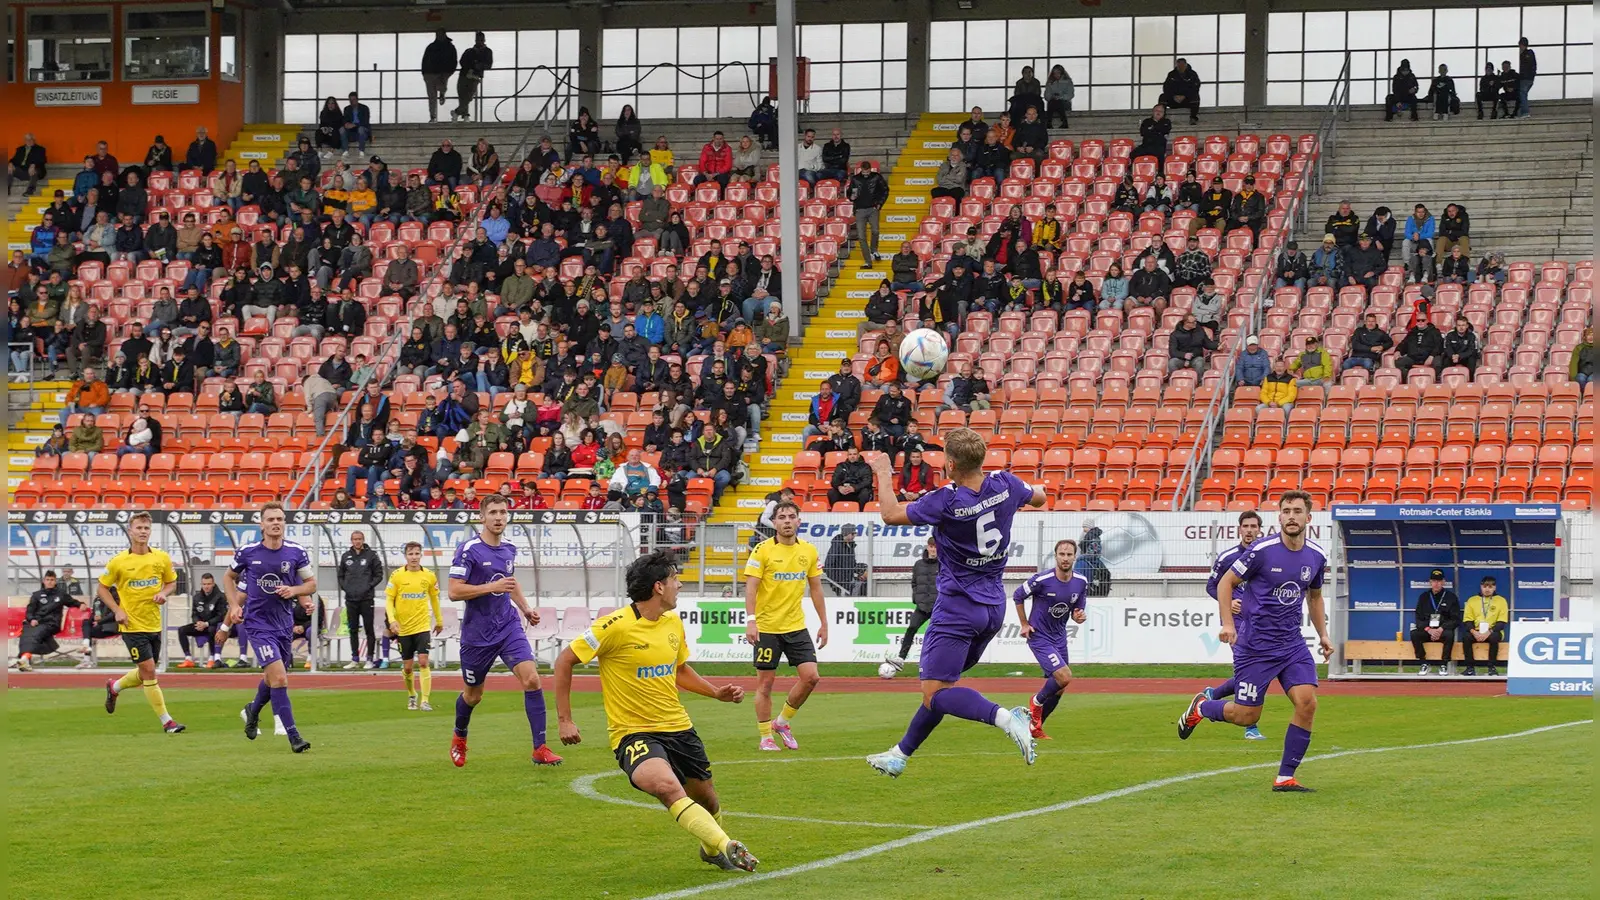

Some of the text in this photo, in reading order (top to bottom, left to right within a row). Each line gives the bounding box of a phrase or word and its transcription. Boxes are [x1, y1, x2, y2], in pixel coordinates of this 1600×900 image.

[36, 92, 98, 101] EINSATZLEITUNG
[152, 90, 178, 99] REGIE
[47, 512, 67, 520] bwin
[88, 512, 108, 520] bwin
[182, 512, 202, 520] bwin
[224, 512, 244, 520] bwin
[308, 512, 327, 520] bwin
[342, 512, 362, 520] bwin
[385, 512, 404, 520] bwin
[427, 512, 447, 520] bwin
[976, 510, 1003, 556] 6
[1124, 608, 1214, 626] Fenster
[131, 647, 139, 660] 9
[258, 645, 274, 662] 14
[756, 647, 772, 663] 29
[1048, 653, 1060, 667] 3
[465, 669, 476, 684] 5
[1238, 682, 1258, 701] 24
[626, 740, 649, 765] 25
